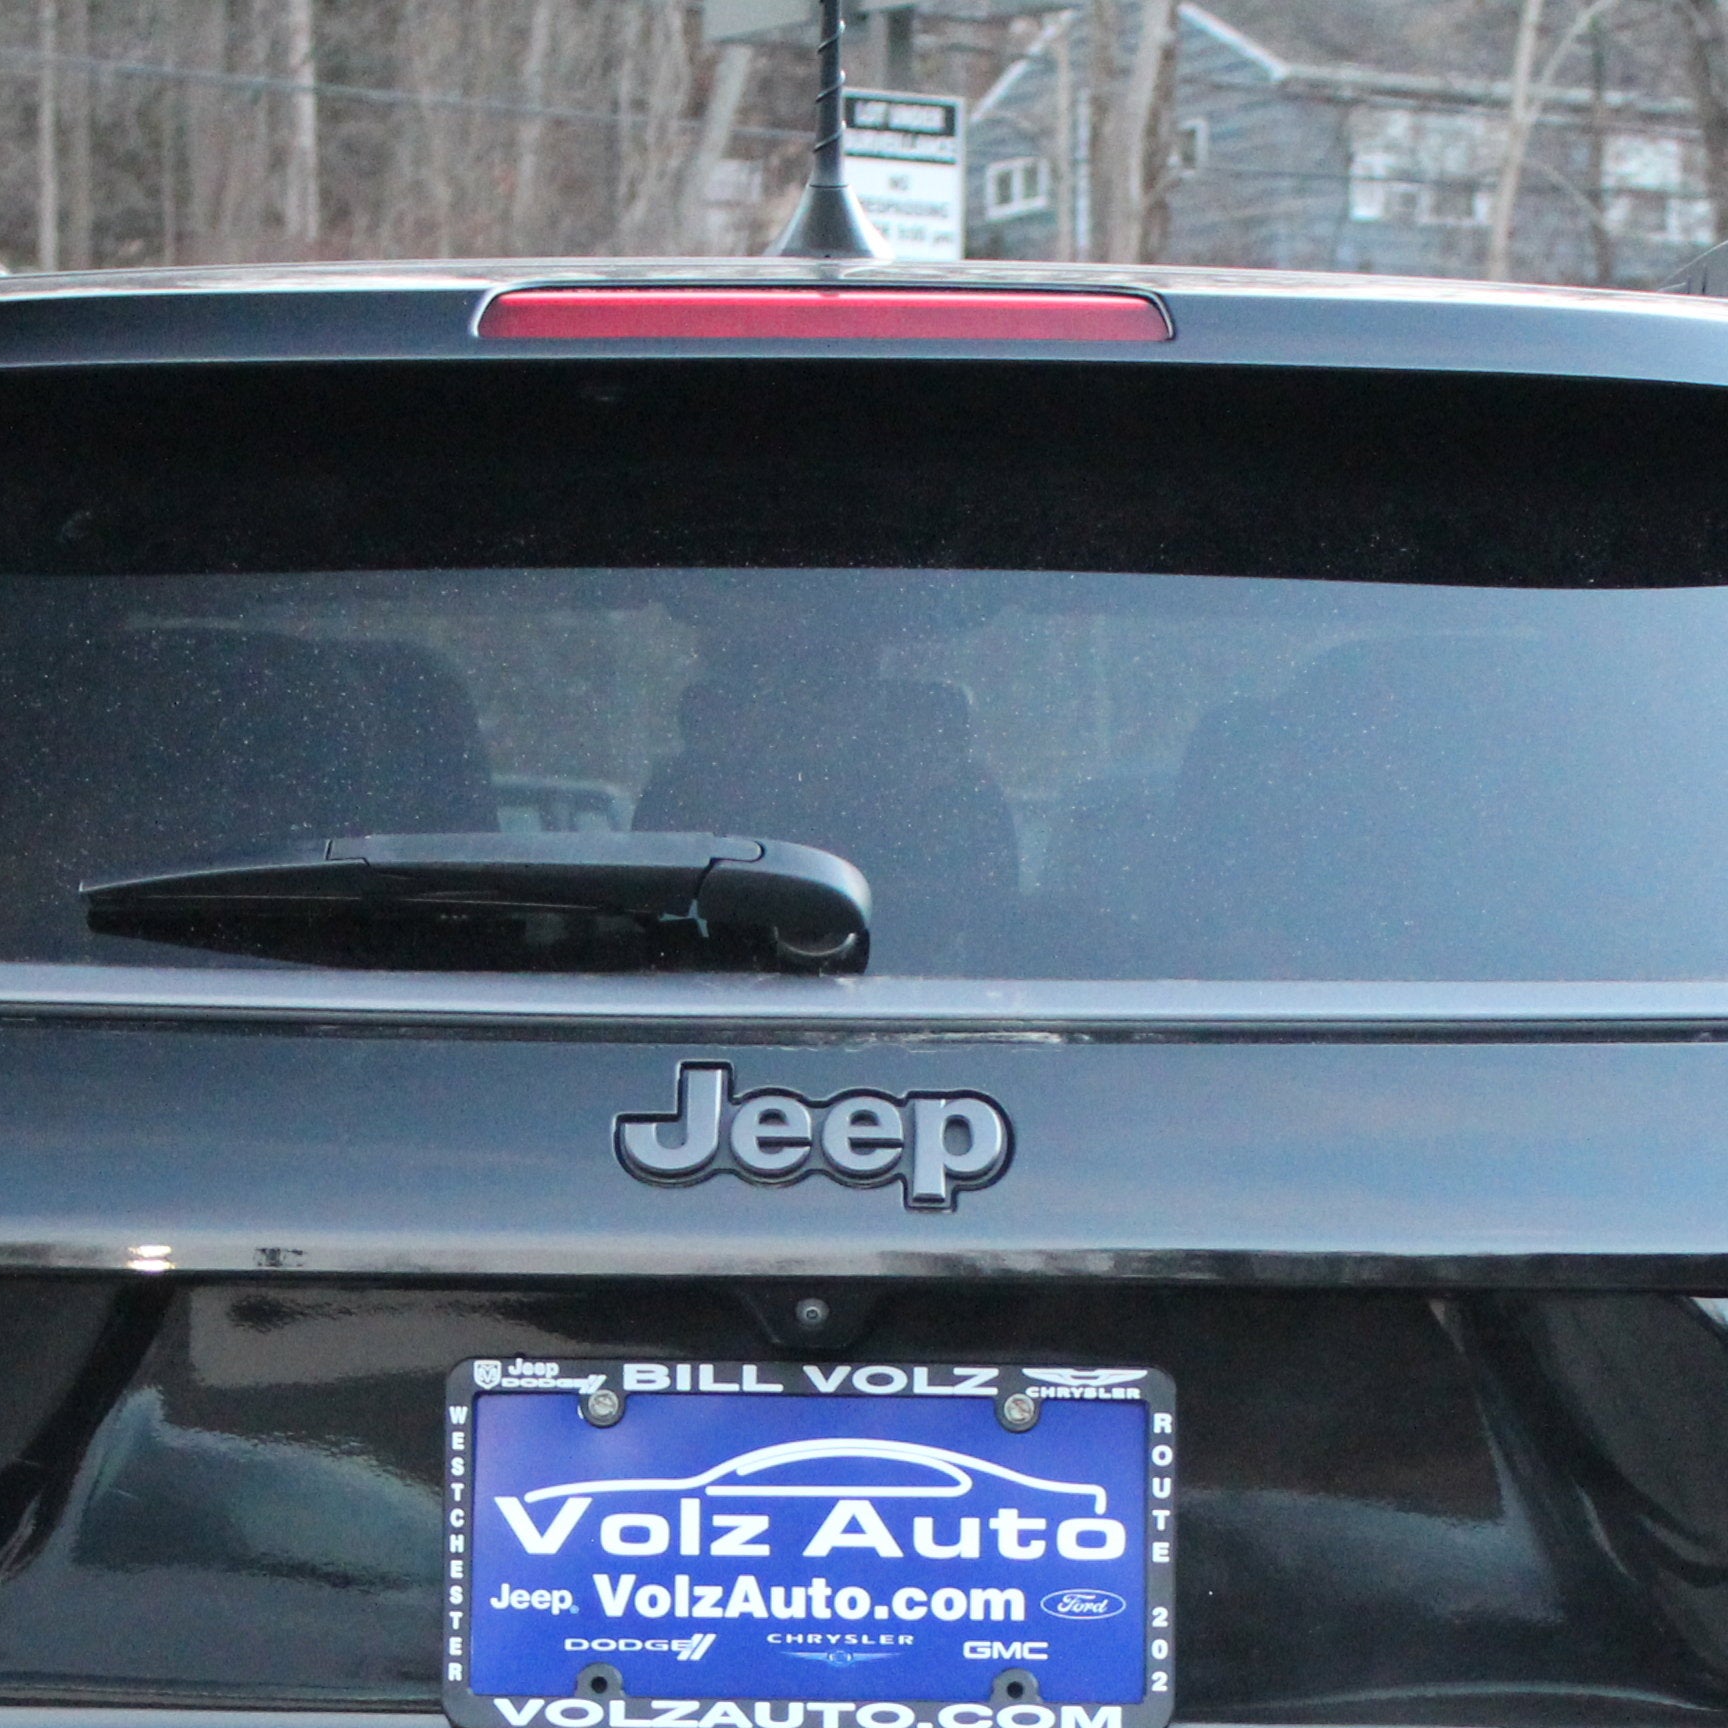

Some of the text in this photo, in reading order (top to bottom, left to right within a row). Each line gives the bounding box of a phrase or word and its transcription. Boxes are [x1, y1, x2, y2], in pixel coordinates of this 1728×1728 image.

[615, 1060, 1015, 1211] Jeep
[508, 1358, 559, 1377] Jeep
[622, 1363, 1000, 1396] BILL VOLZ
[1025, 1386, 1141, 1399] CHRYSLER
[448, 1406, 468, 1682] WESTCHESTER
[494, 1496, 1127, 1560] Volz Auto
[1151, 1412, 1173, 1692] ROUTE 202
[490, 1583, 573, 1615] Jeep
[592, 1573, 1025, 1621] VolzAuto.com
[1057, 1593, 1109, 1613] Ford
[564, 1638, 691, 1651] DODGE
[766, 1633, 914, 1645] CHRYSLER
[962, 1641, 1049, 1660] GMC
